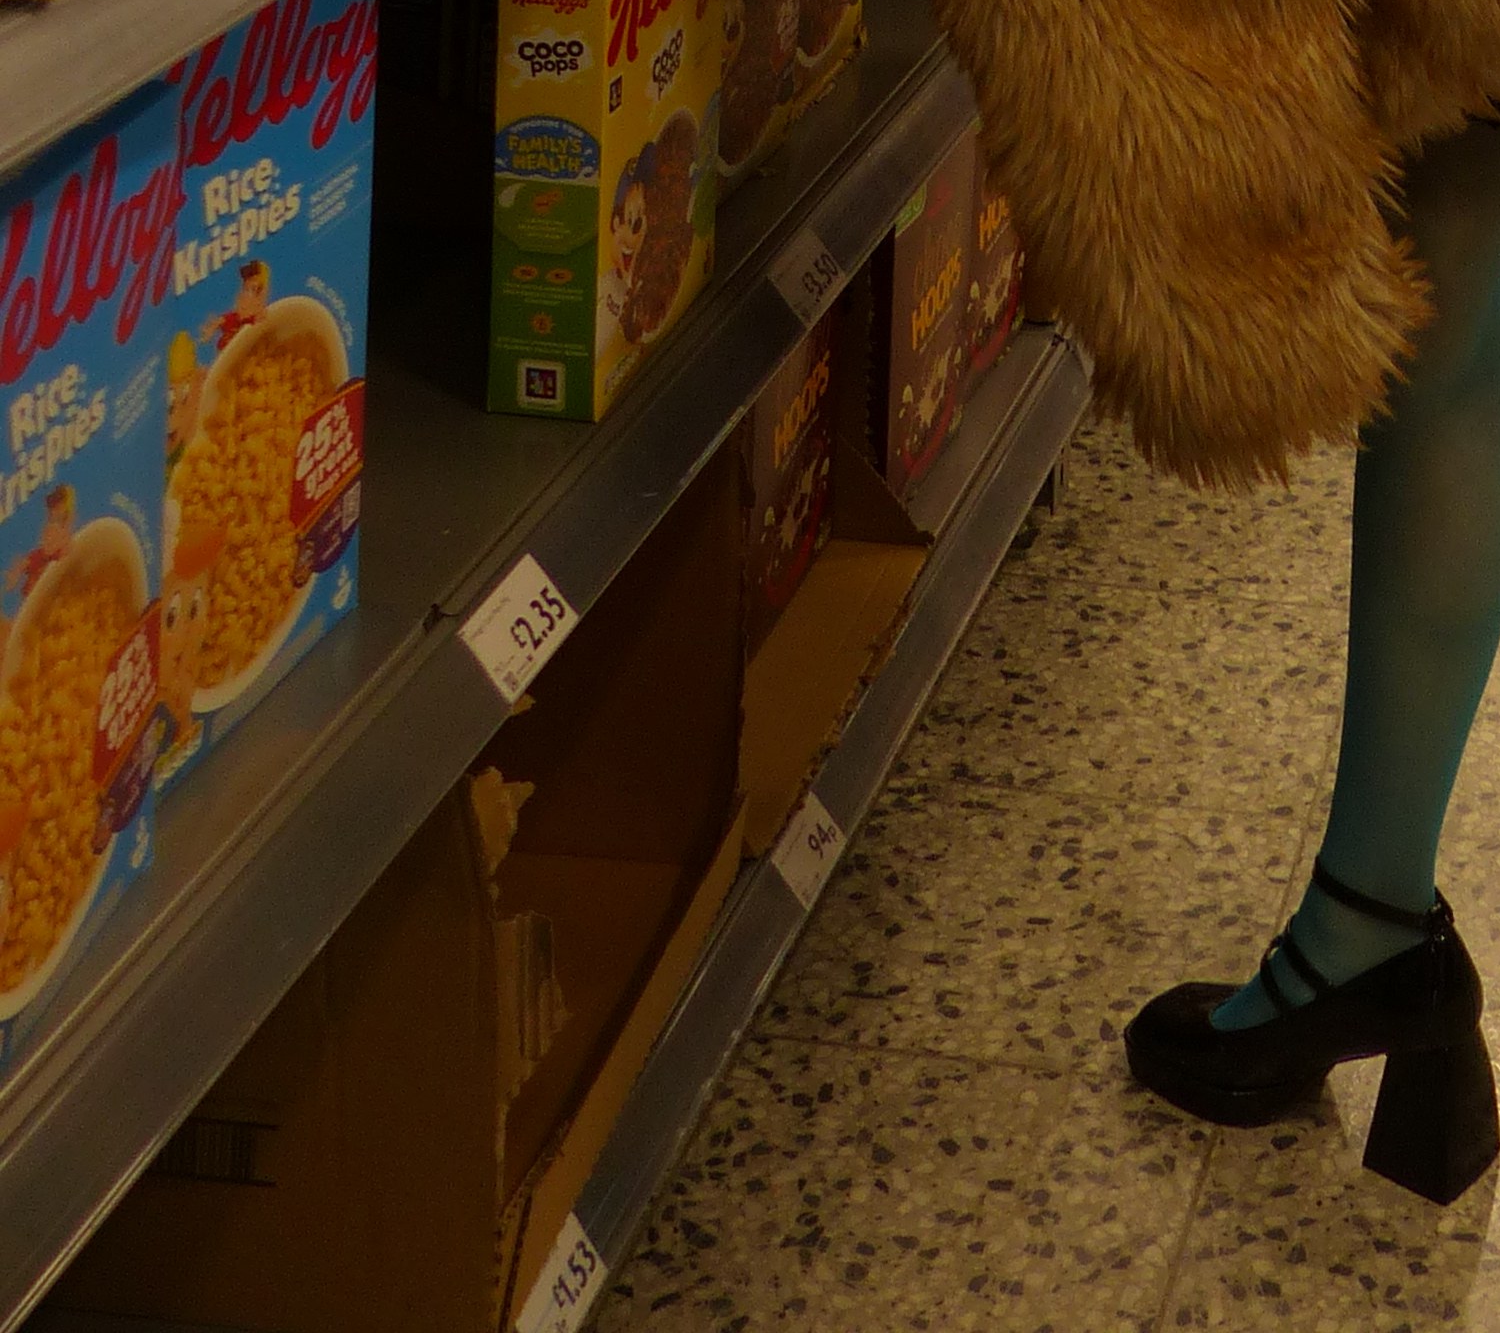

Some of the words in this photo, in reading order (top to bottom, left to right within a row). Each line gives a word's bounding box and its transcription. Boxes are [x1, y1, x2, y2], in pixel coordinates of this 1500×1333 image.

[530, 54, 580, 78] pops
[506, 131, 583, 154] FAMILY'S
[511, 152, 583, 174] HEALTH
[203, 158, 277, 225] Rice
[173, 182, 303, 296] Krispies
[912, 246, 962, 352] HOOPS
[9, 363, 86, 453] Rice
[773, 349, 830, 470] HOOPS
[509, 585, 567, 650] £2.35
[807, 821, 838, 860] 94p
[551, 1239, 598, 1310] £1.53
